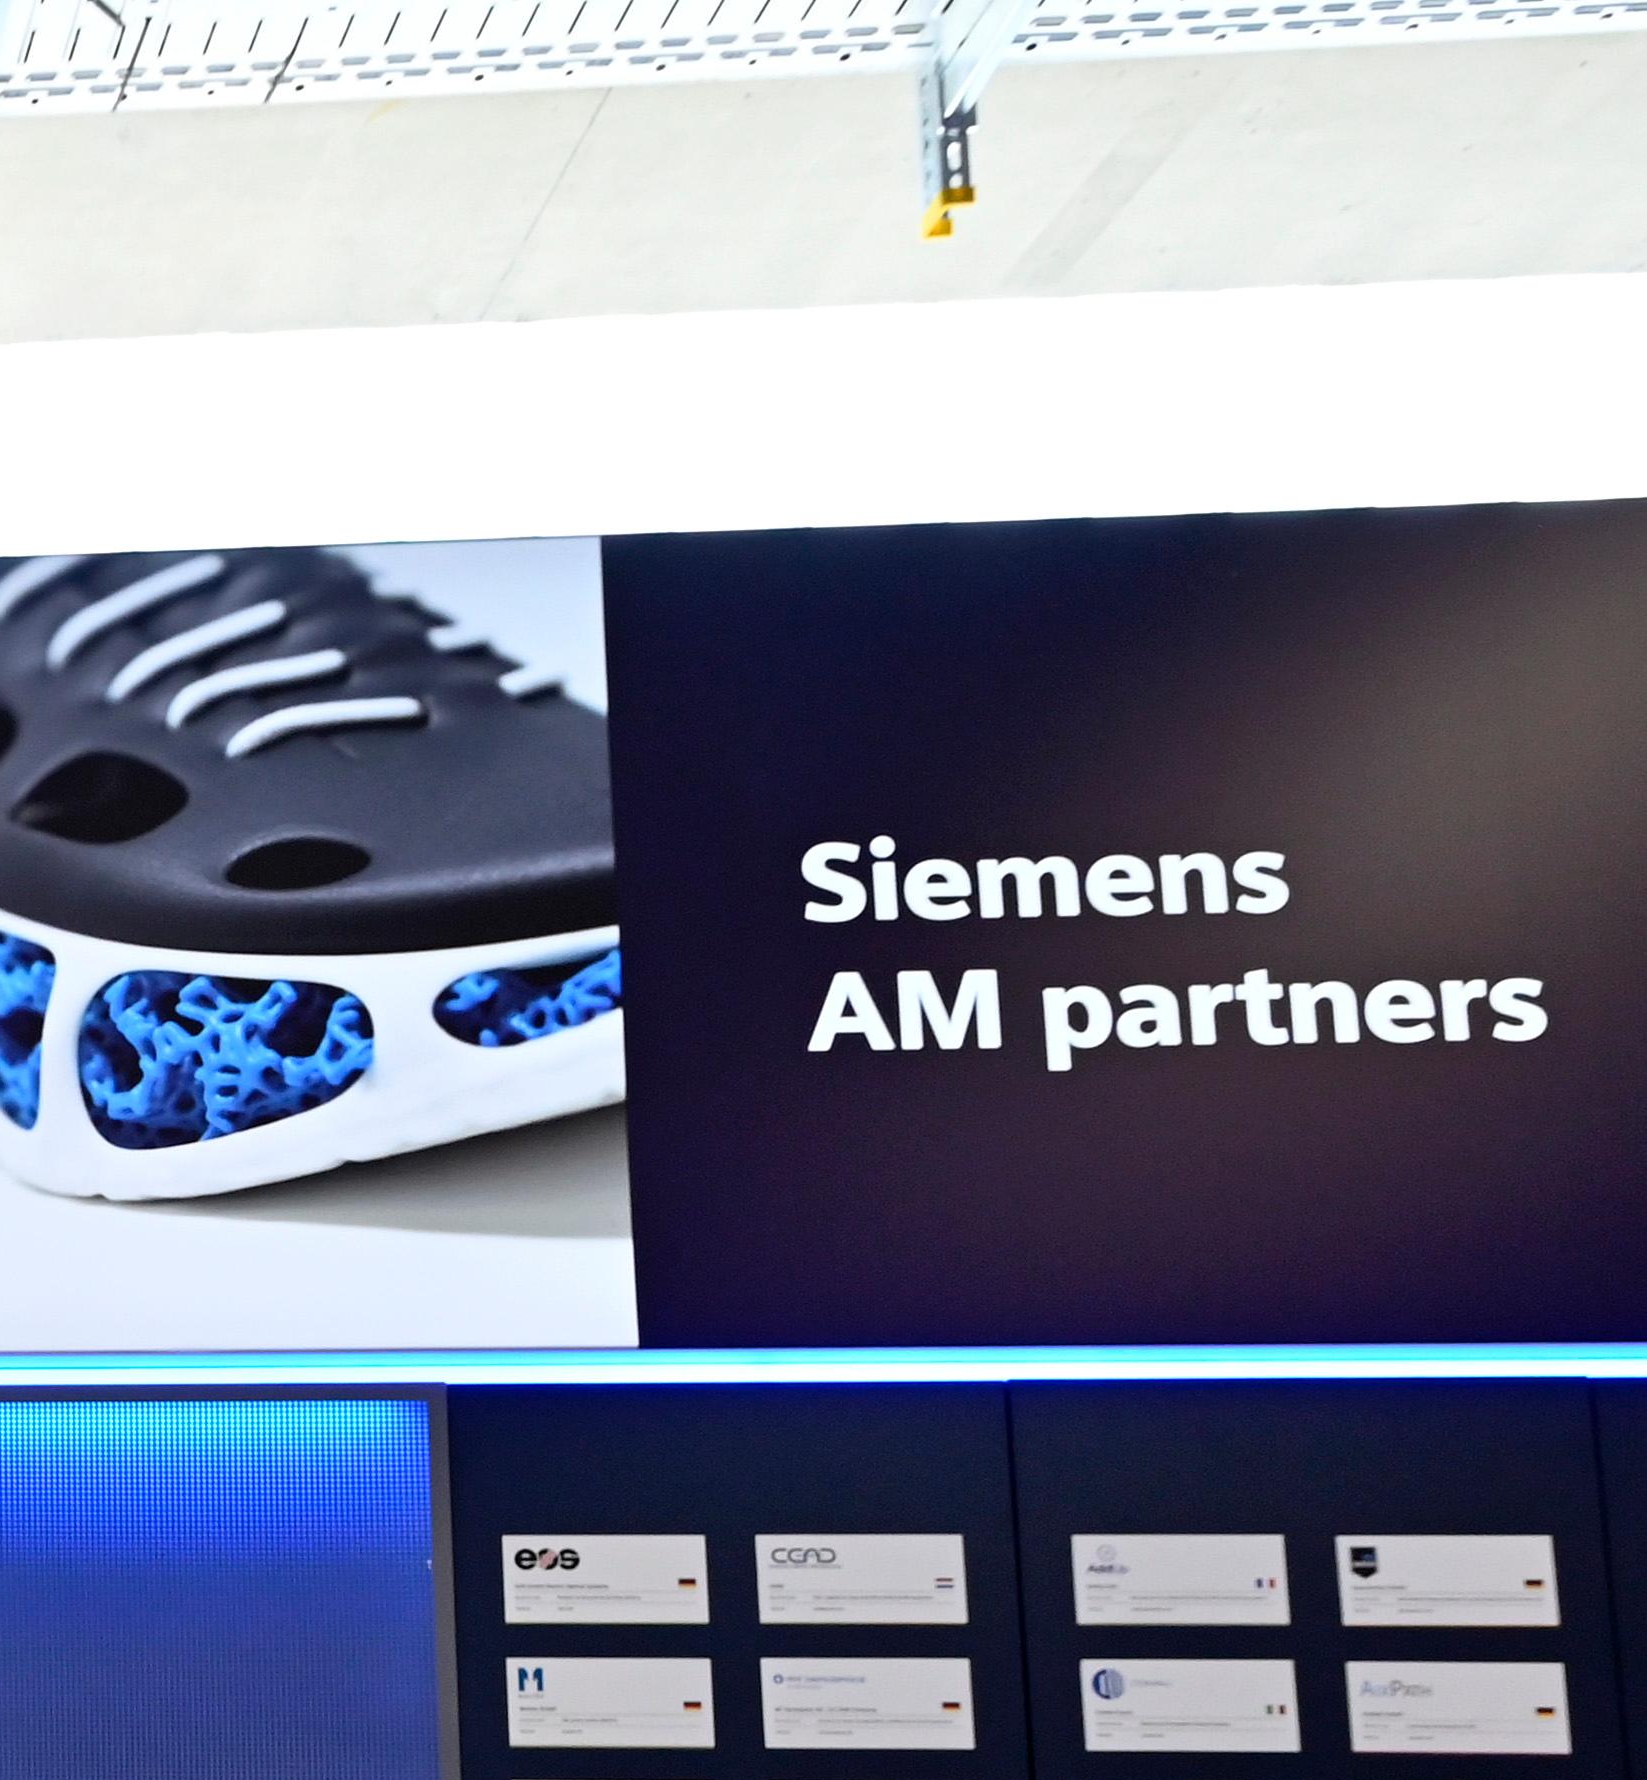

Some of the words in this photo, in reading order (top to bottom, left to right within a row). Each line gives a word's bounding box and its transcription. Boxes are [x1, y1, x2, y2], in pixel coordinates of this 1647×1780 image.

[802, 836, 1289, 923] Siemens
[807, 970, 1002, 1052] AM
[1043, 968, 1548, 1072] partners
